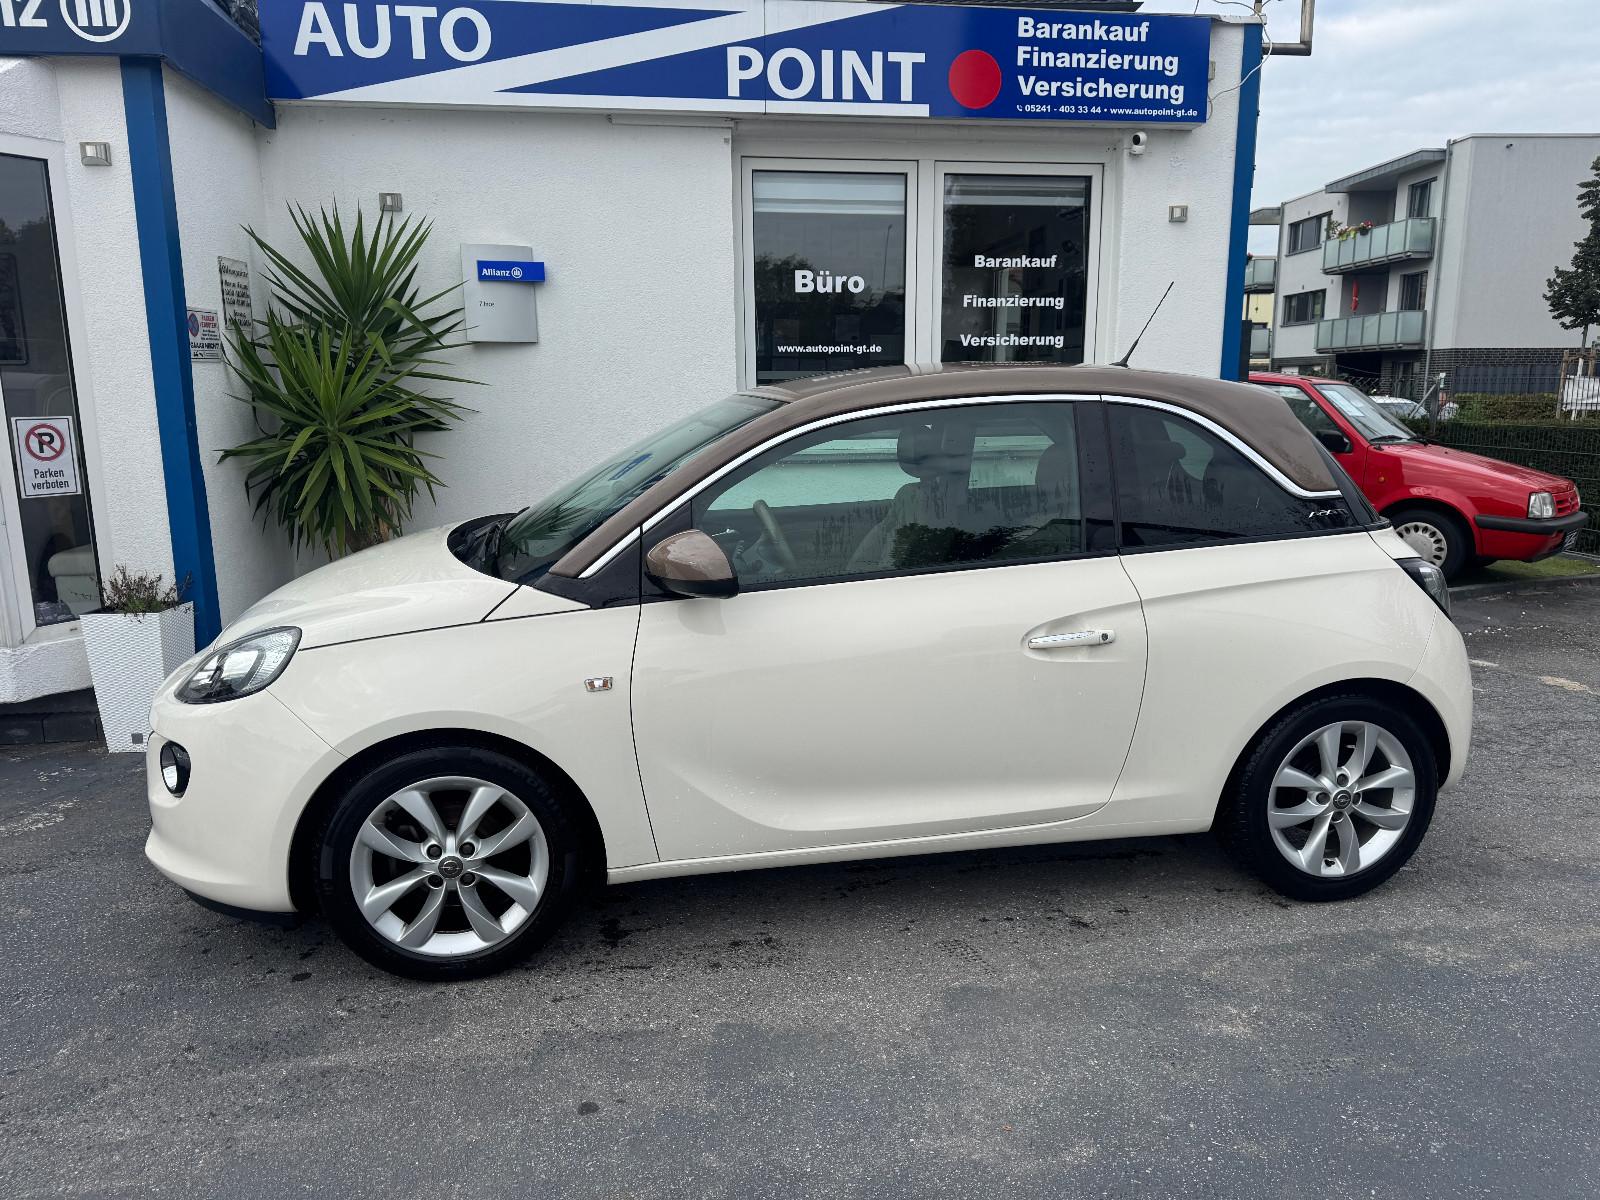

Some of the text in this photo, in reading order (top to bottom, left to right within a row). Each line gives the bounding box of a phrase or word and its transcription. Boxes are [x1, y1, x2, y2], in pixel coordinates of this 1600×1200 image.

[294, 1, 492, 62] AUTO
[1017, 16, 1149, 42] Barankauf
[1016, 45, 1179, 76] Finanzierung
[726, 46, 926, 102] POINT
[1017, 75, 1185, 105] Versicherung
[1024, 104, 1051, 113] 05241
[1059, 105, 1076, 114] 403
[1077, 105, 1089, 114] 33
[1090, 105, 1102, 114] 44
[1110, 107, 1198, 118] www.autopoint-gt.de
[974, 254, 1058, 268] Barankauf
[481, 268, 511, 277] Allianz
[794, 269, 865, 294] Büro
[963, 294, 1065, 310] Finanzierung
[959, 333, 1064, 348] Versicherung
[777, 344, 882, 355] www.autopoint-gt.de
[33, 468, 65, 479] Parken
[31, 479, 70, 491] verboten
